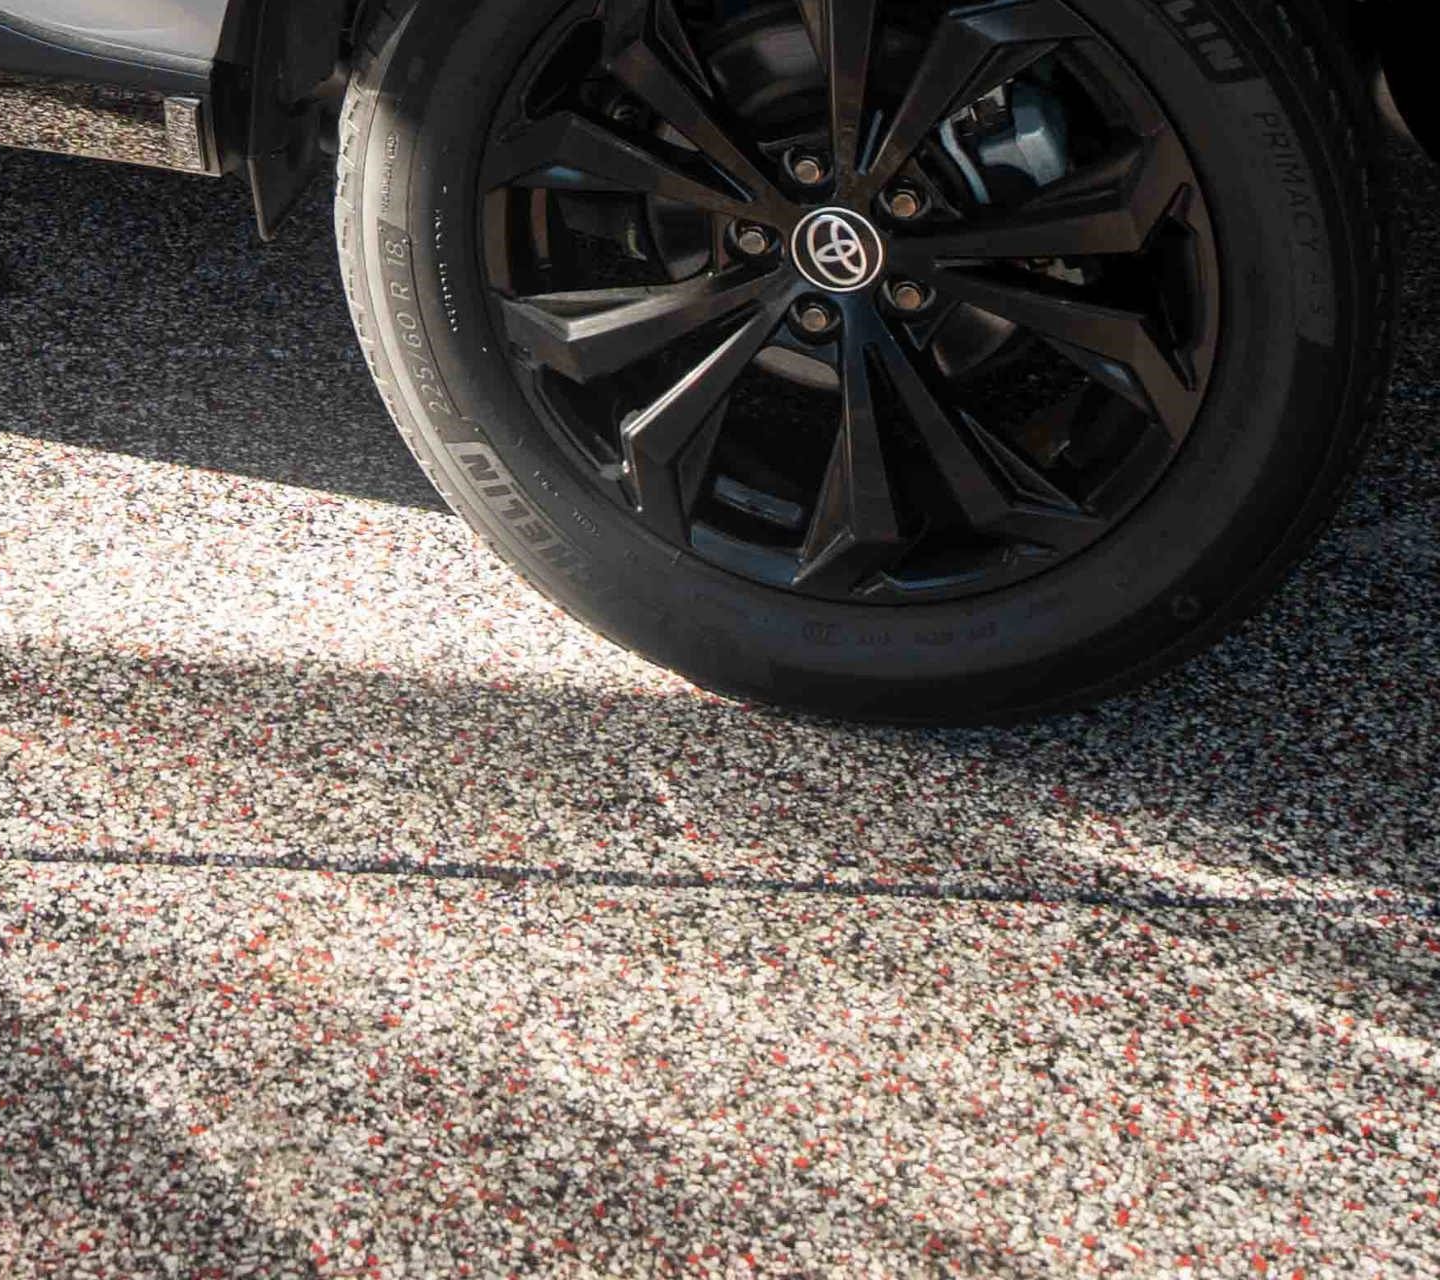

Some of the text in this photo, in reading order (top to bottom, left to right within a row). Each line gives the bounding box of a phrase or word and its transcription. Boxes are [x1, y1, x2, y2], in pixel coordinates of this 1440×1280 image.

[1252, 109, 1323, 252] PRIMACY
[383, 238, 408, 270] 18
[388, 284, 413, 312] R
[398, 310, 454, 418] 225/60
